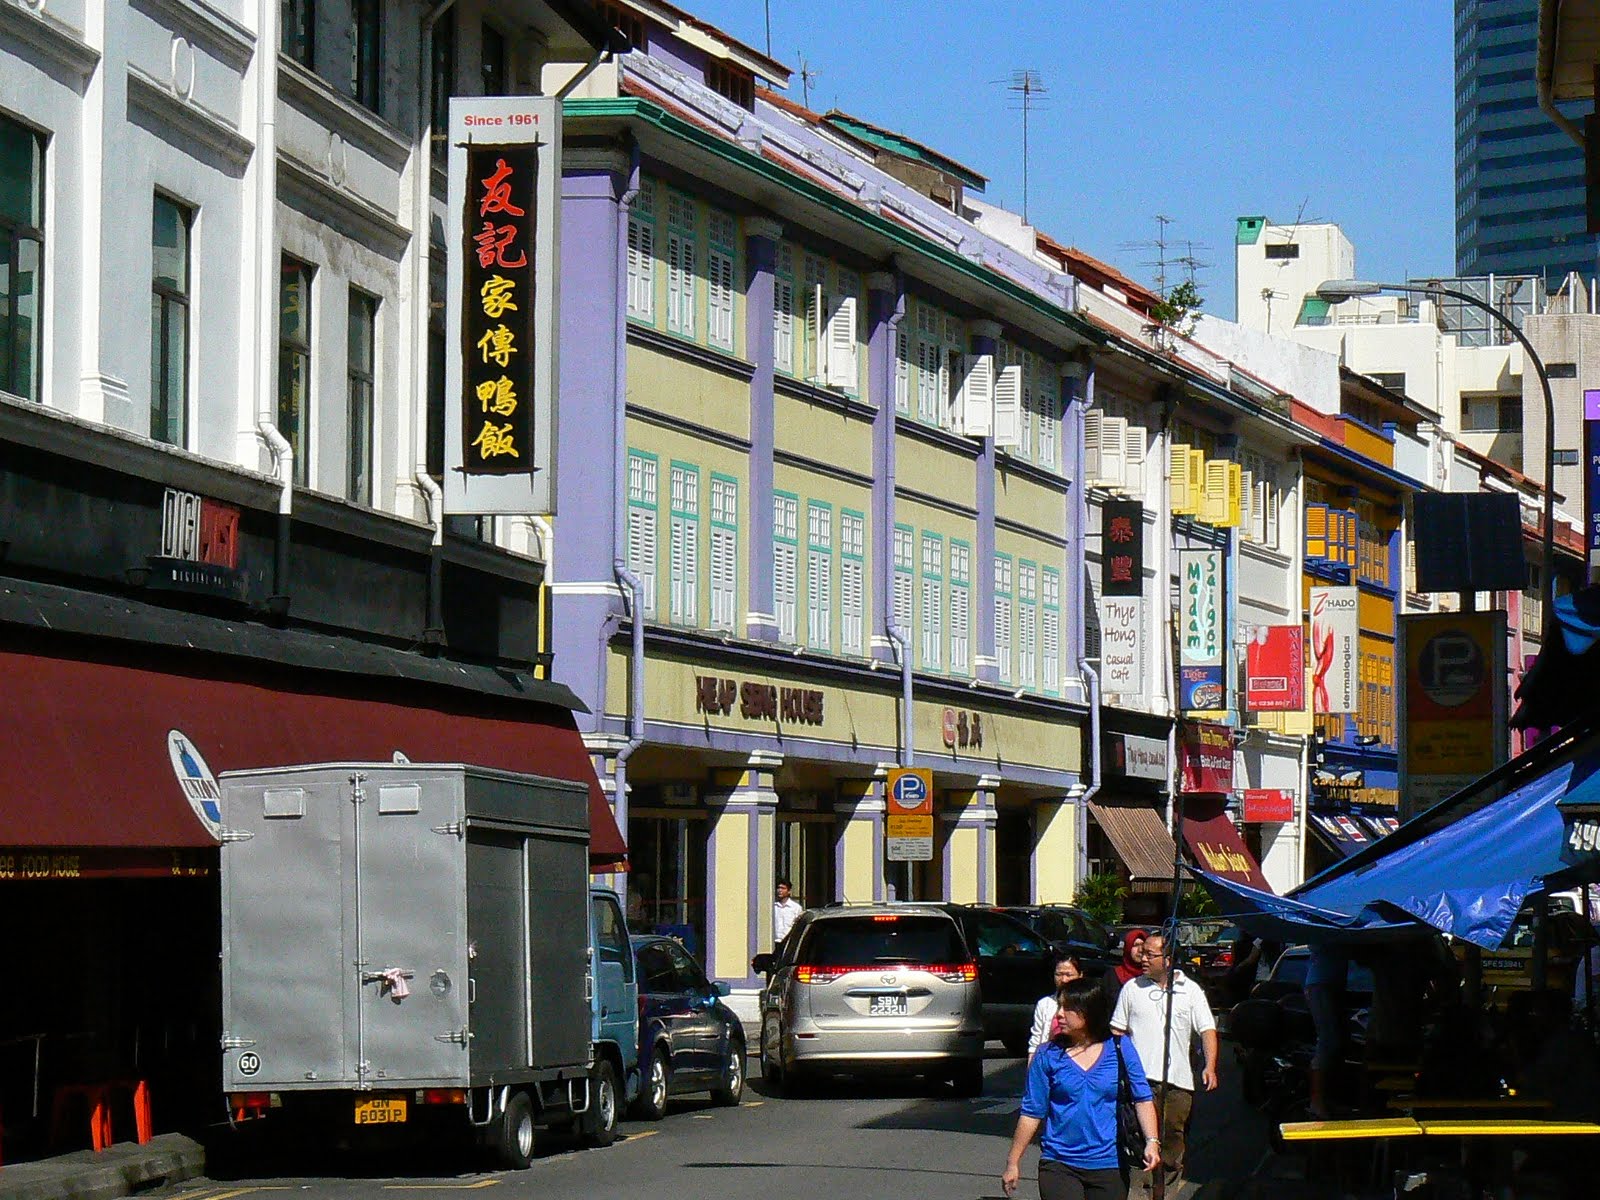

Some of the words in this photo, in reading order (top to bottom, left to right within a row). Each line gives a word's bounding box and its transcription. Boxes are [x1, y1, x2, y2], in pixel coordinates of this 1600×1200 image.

[464, 115, 503, 126] Since
[507, 114, 540, 125] 1961
[1105, 603, 1135, 627] Thye
[1187, 561, 1201, 649] Madam
[1206, 553, 1217, 657] Saigon
[1104, 627, 1136, 648] Hong
[1182, 668, 1208, 682] Tiger
[1342, 635, 1351, 709] dermalogica
[696, 675, 737, 717] HEAP
[780, 686, 824, 726] HOUSE
[870, 1005, 907, 1015] 2232U
[877, 996, 899, 1006] SBV
[241, 1056, 258, 1069] 60
